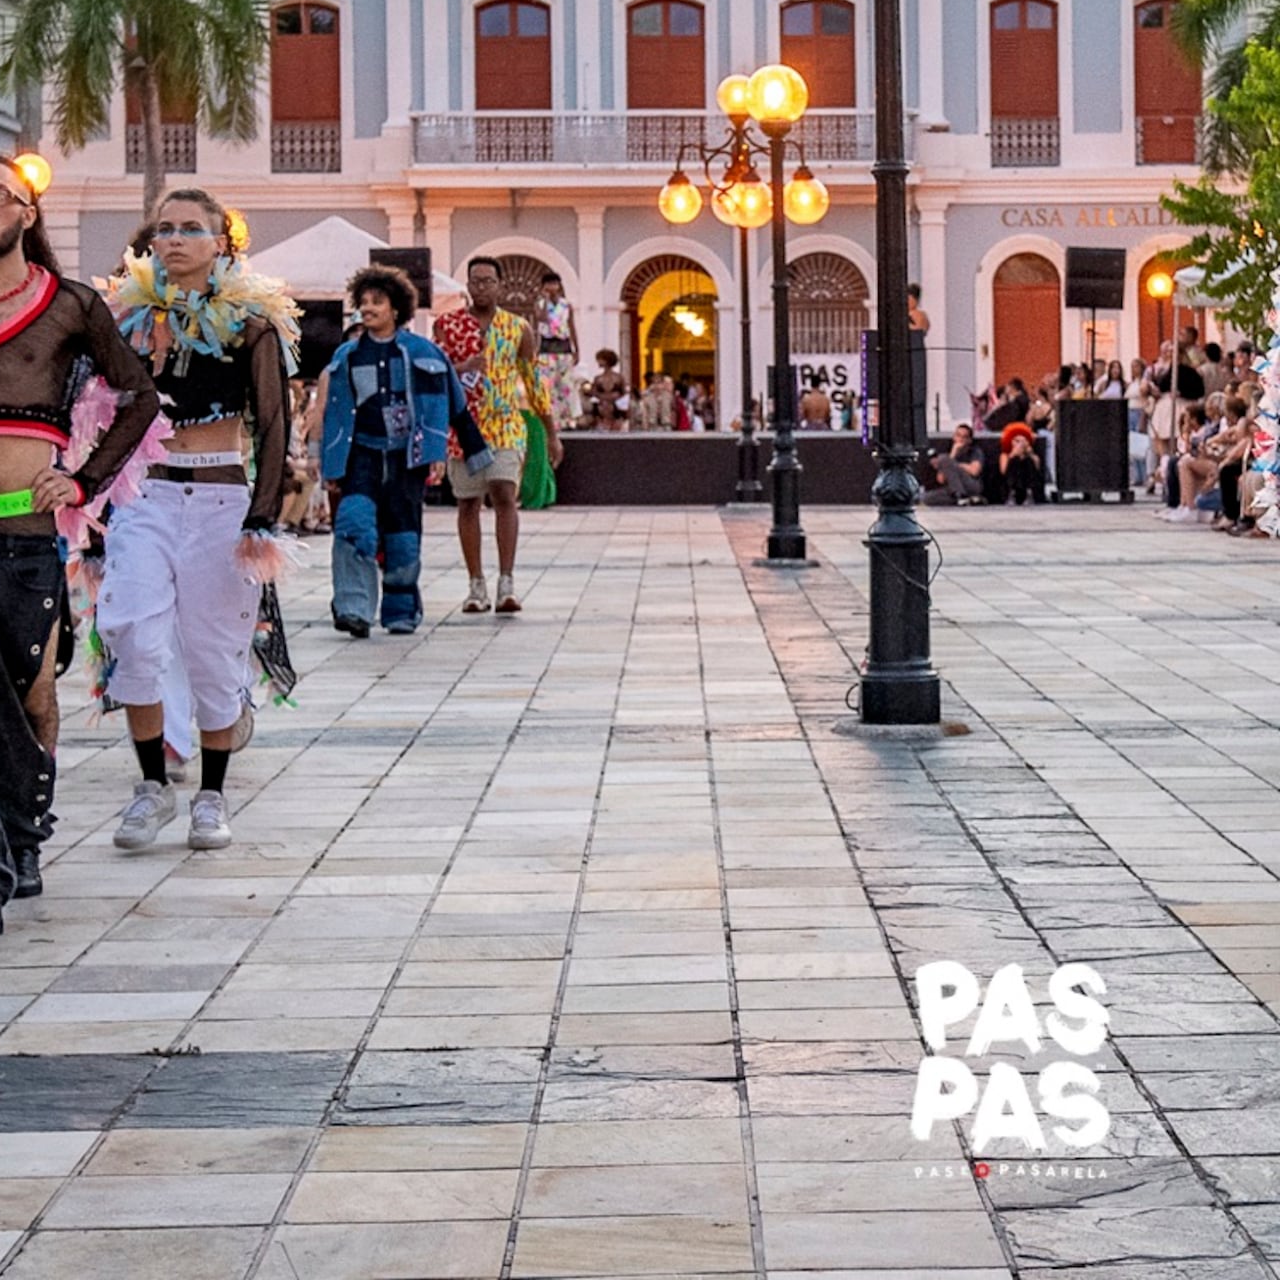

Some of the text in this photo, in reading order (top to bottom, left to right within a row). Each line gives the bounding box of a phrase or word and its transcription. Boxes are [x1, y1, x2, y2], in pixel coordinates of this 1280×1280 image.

[1001, 207, 1175, 227] CASA ALCALD
[1, 498, 30, 511] lec
